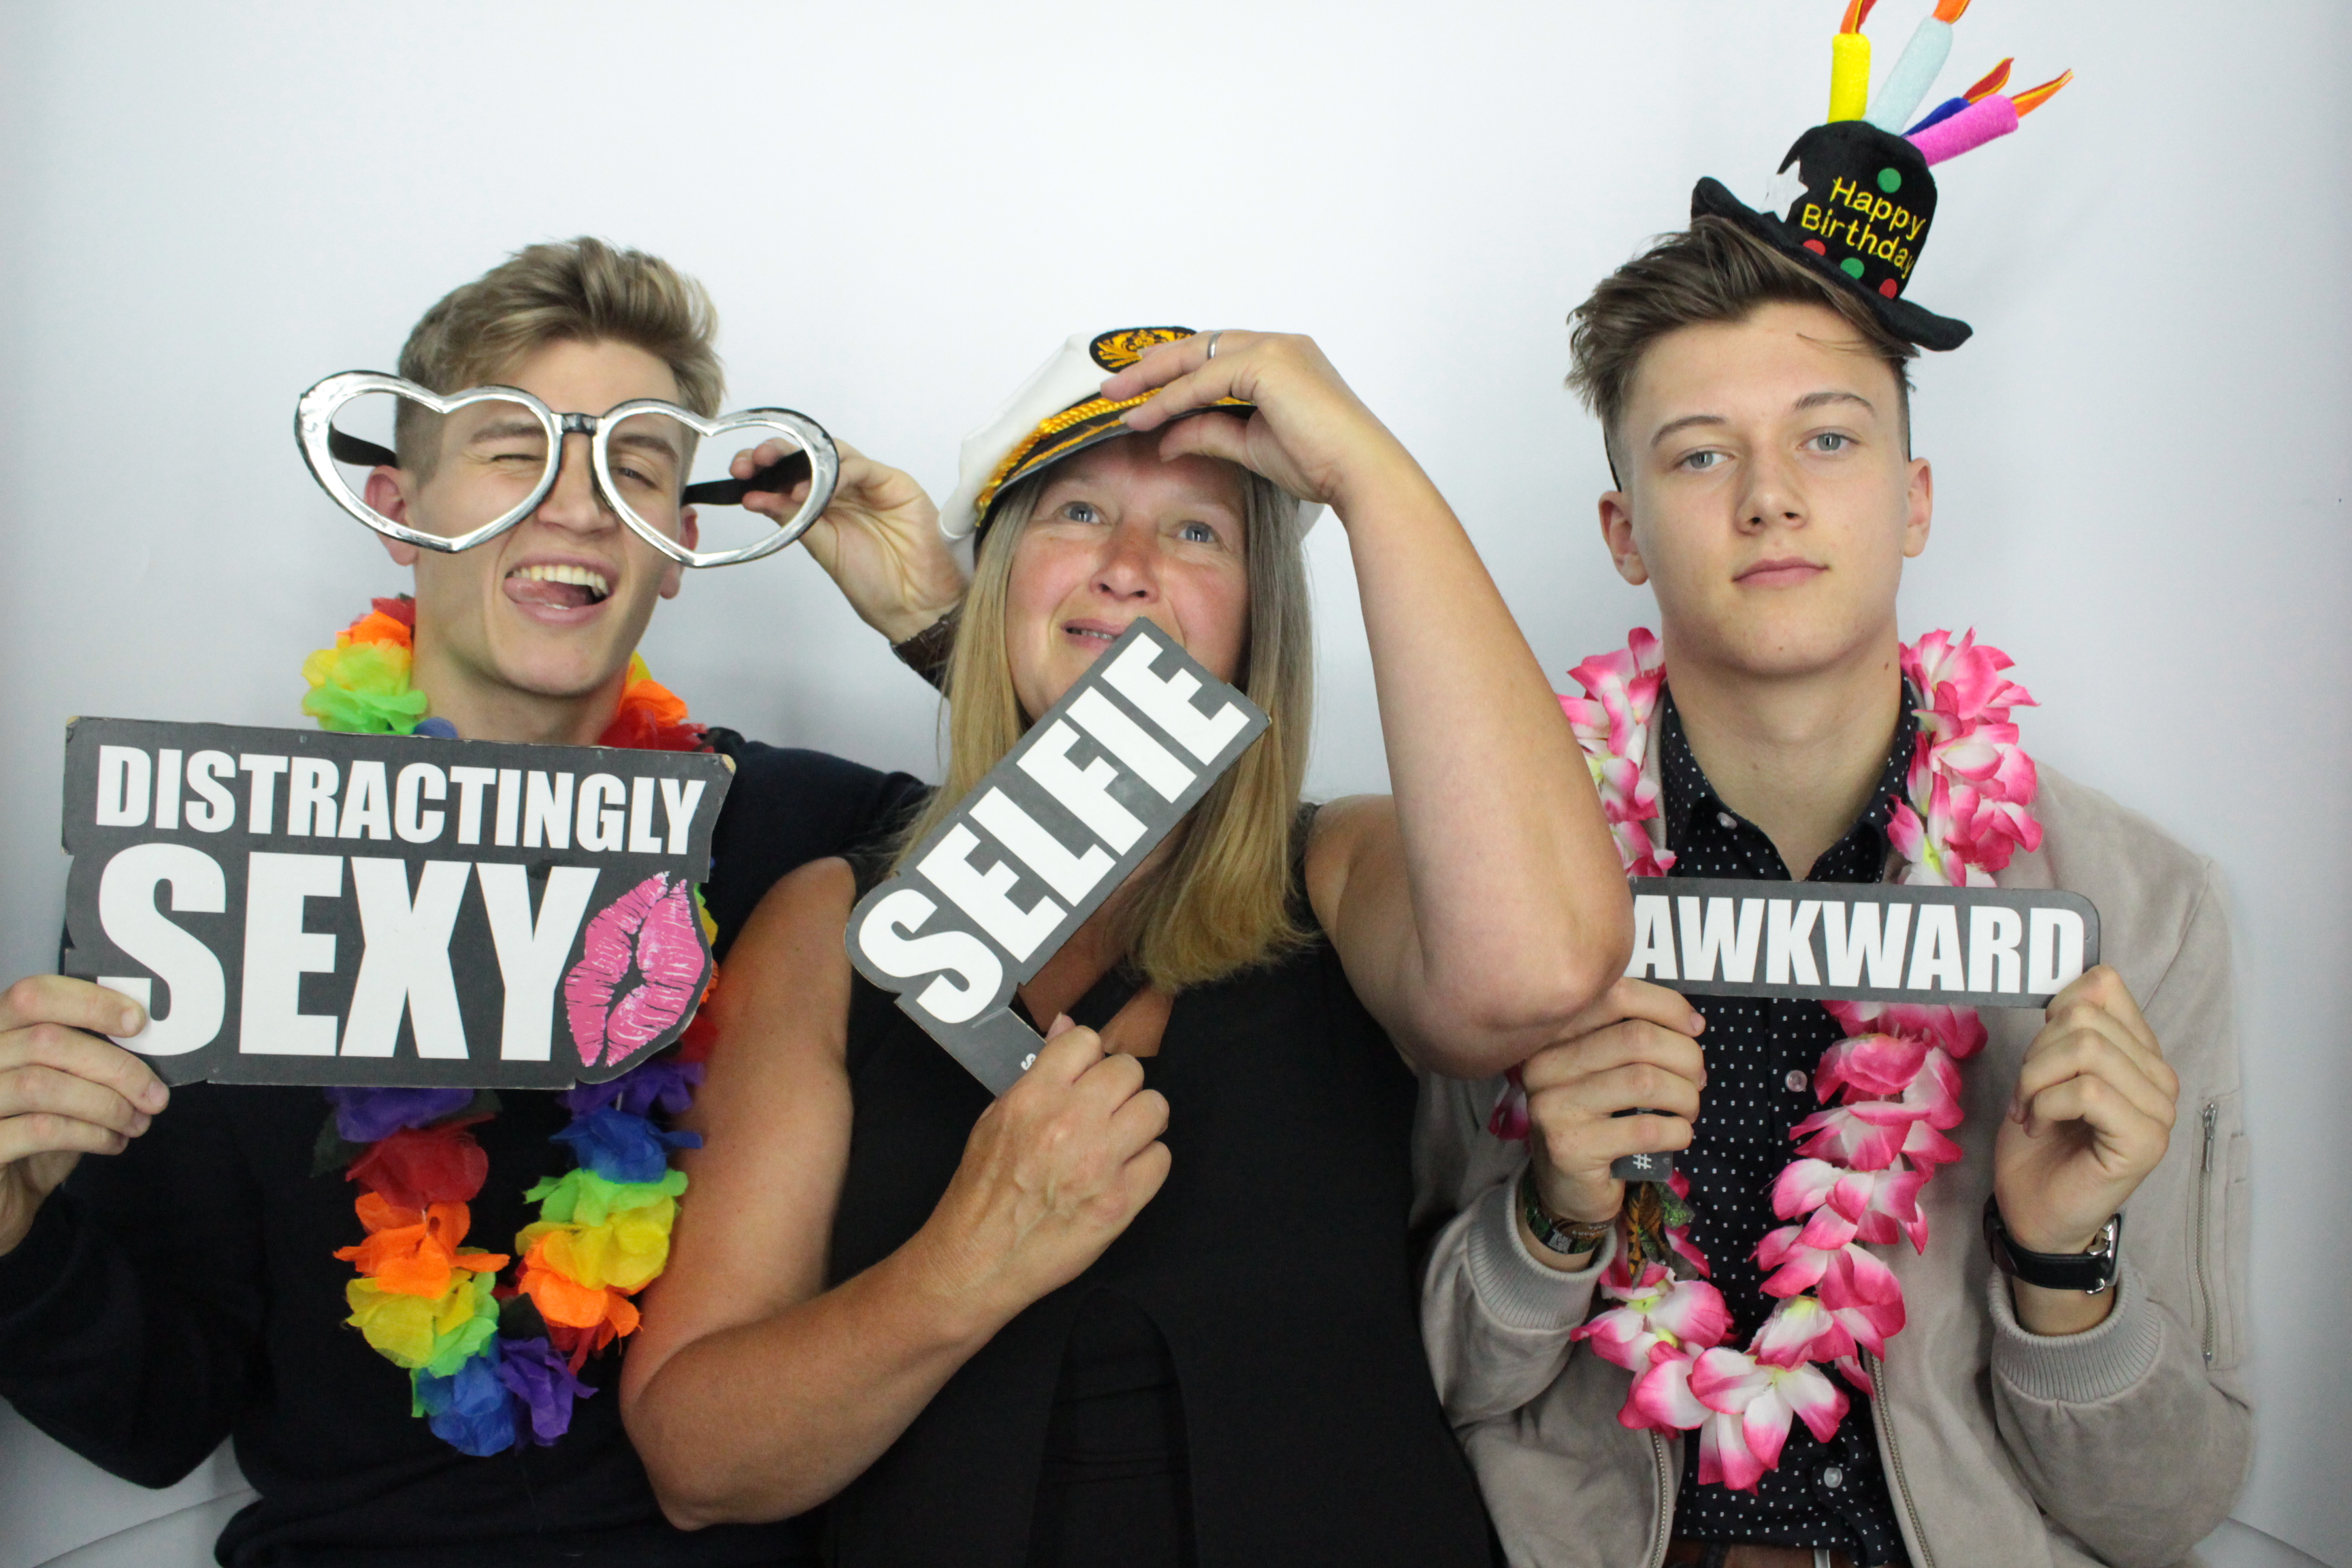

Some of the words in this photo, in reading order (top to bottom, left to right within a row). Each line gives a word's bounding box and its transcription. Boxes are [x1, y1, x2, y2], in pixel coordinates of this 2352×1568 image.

[1801, 203, 1915, 280] Birthday
[1829, 176, 1926, 241] Happy
[96, 745, 706, 855] DISTRACTINGLY
[858, 632, 1251, 1024] SELFIE
[97, 843, 600, 1062] SEXY
[1623, 894, 2085, 995] AWKWARD
